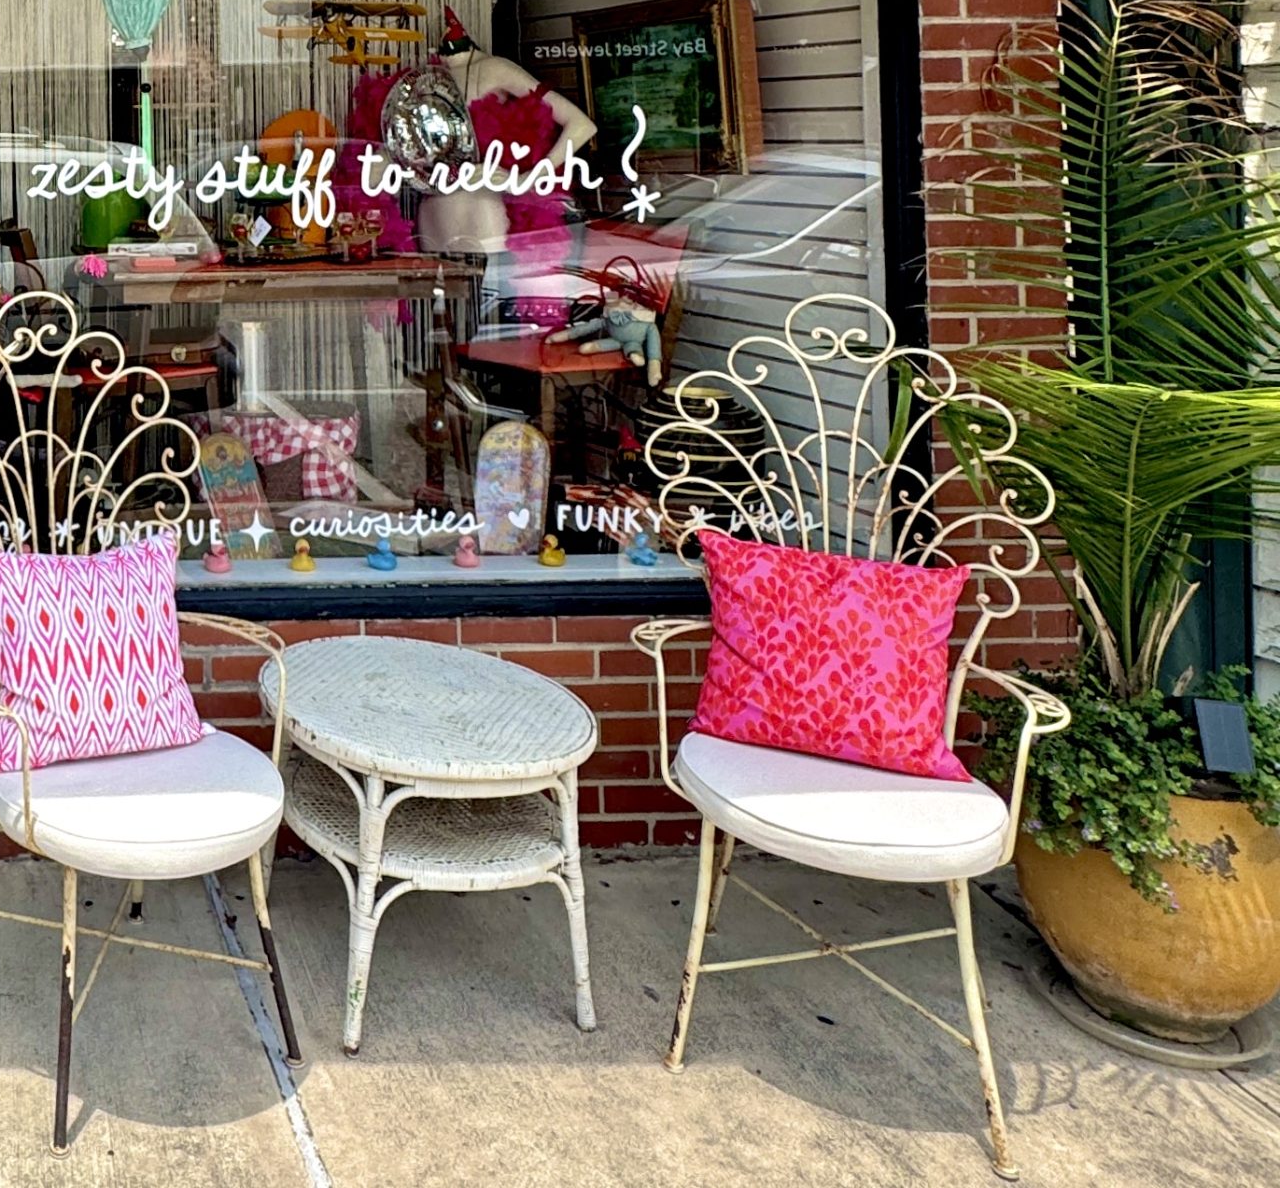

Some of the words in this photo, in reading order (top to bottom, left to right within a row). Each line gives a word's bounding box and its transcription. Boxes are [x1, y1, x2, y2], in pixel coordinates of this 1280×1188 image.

[26, 143, 185, 231] zesty
[195, 143, 337, 229] stuff
[357, 143, 417, 198] to
[289, 507, 485, 539] curiosities
[555, 503, 664, 534] FUNKY
